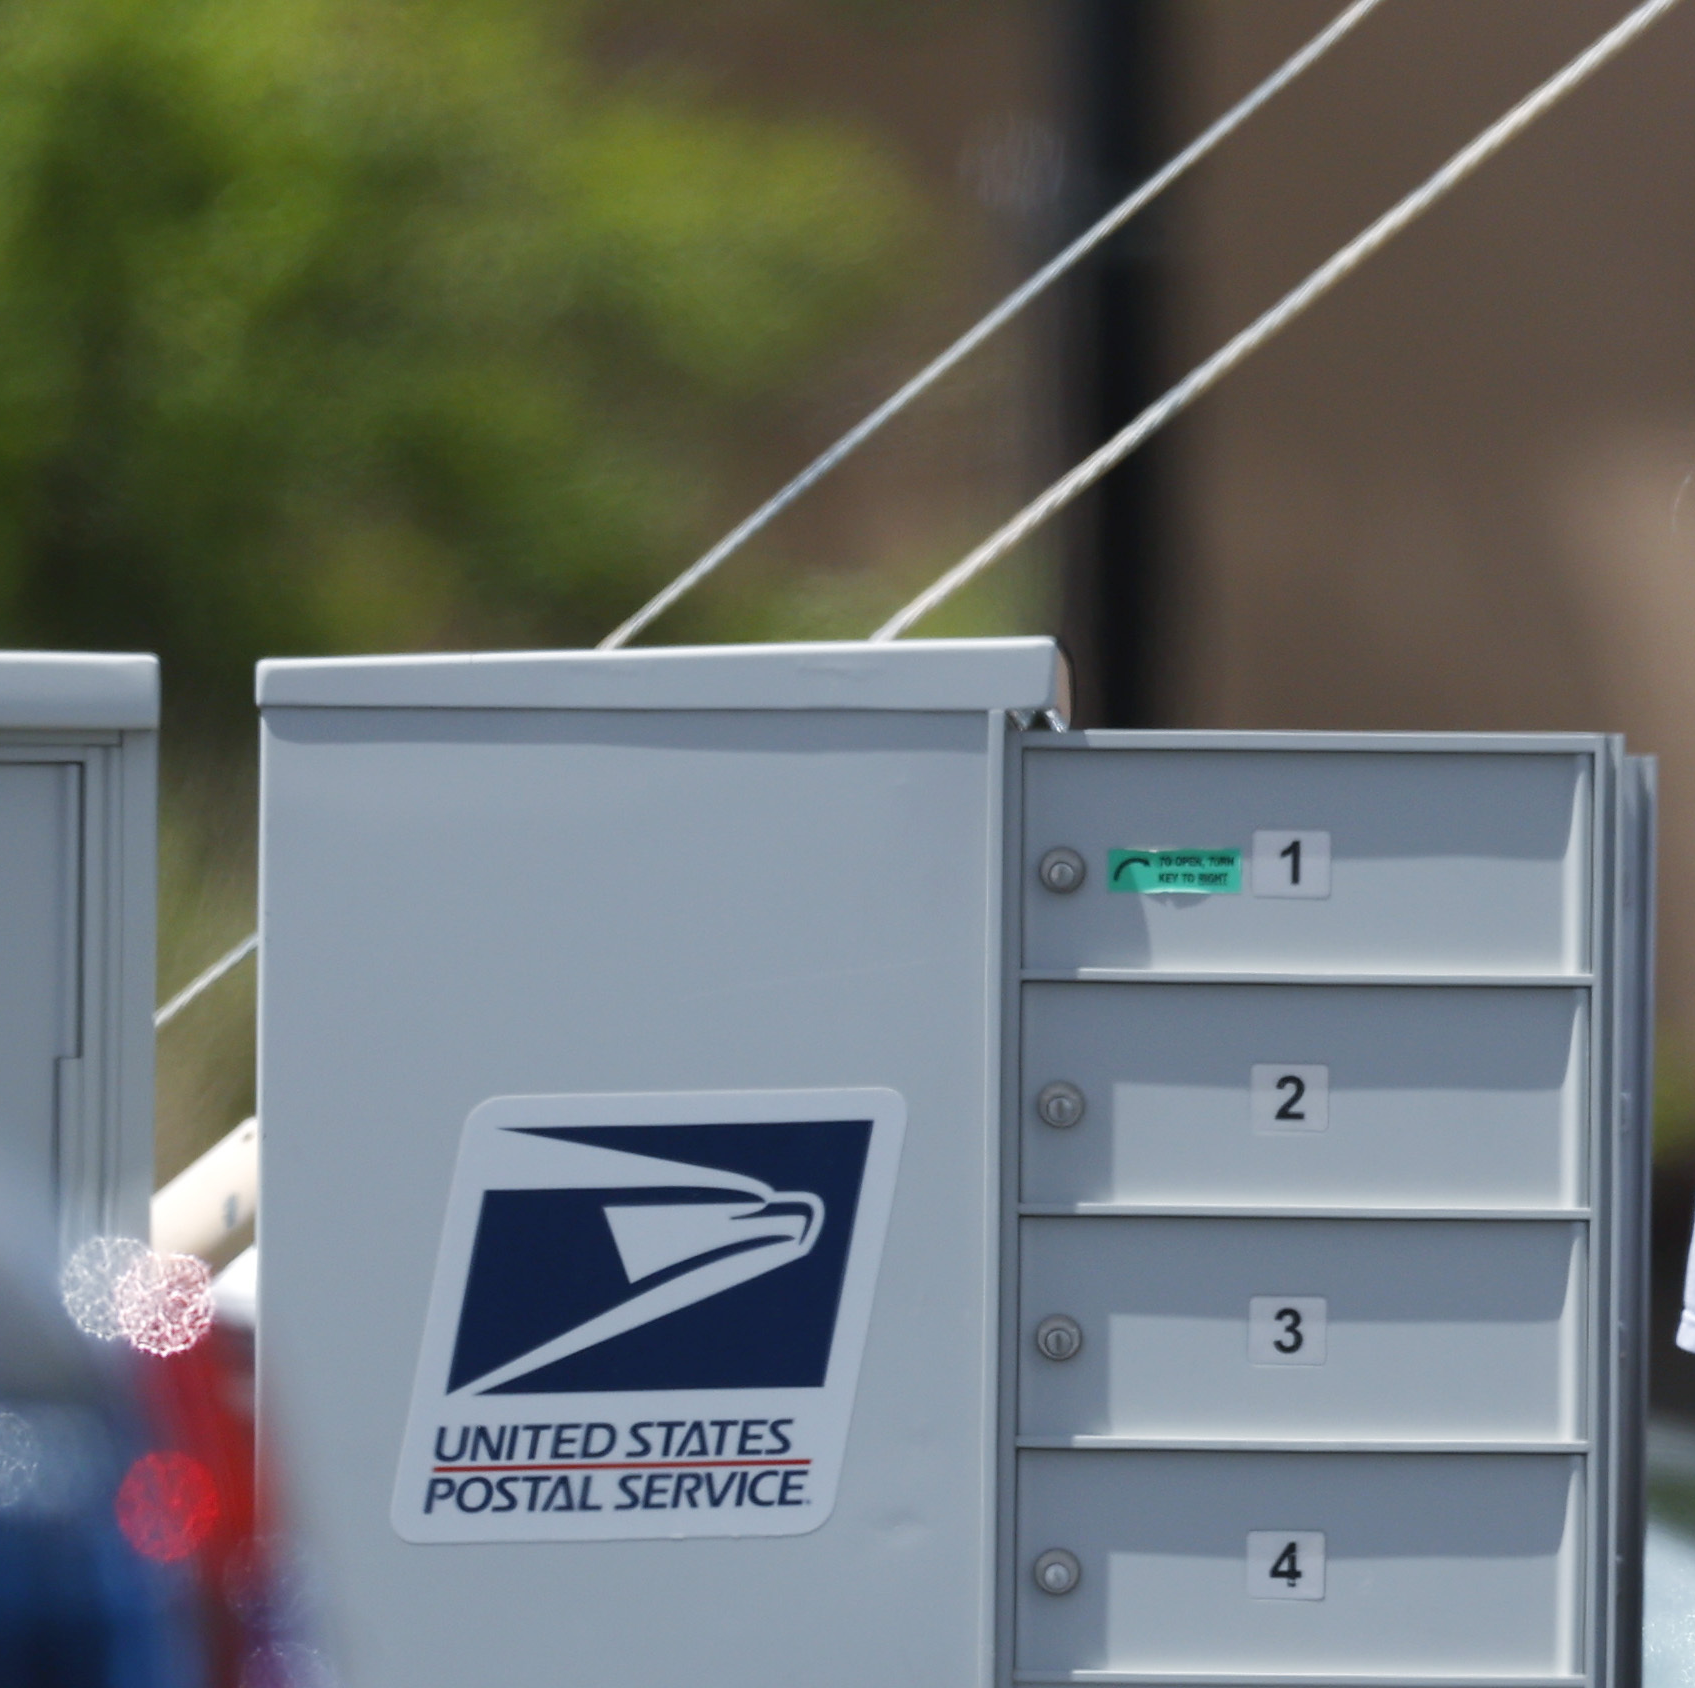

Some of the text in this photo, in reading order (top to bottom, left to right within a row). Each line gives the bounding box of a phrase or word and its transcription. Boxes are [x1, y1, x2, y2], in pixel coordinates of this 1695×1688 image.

[1158, 872, 1228, 885] KEY TO RIGHT
[1160, 855, 1172, 867] TO
[1279, 839, 1302, 885] 1
[1274, 1074, 1306, 1121] 2
[1273, 1306, 1305, 1354] 3
[433, 1417, 795, 1463] UNITED STATES
[422, 1469, 810, 1515] POSTAL SERVICE
[1268, 1541, 1303, 1588] 4
